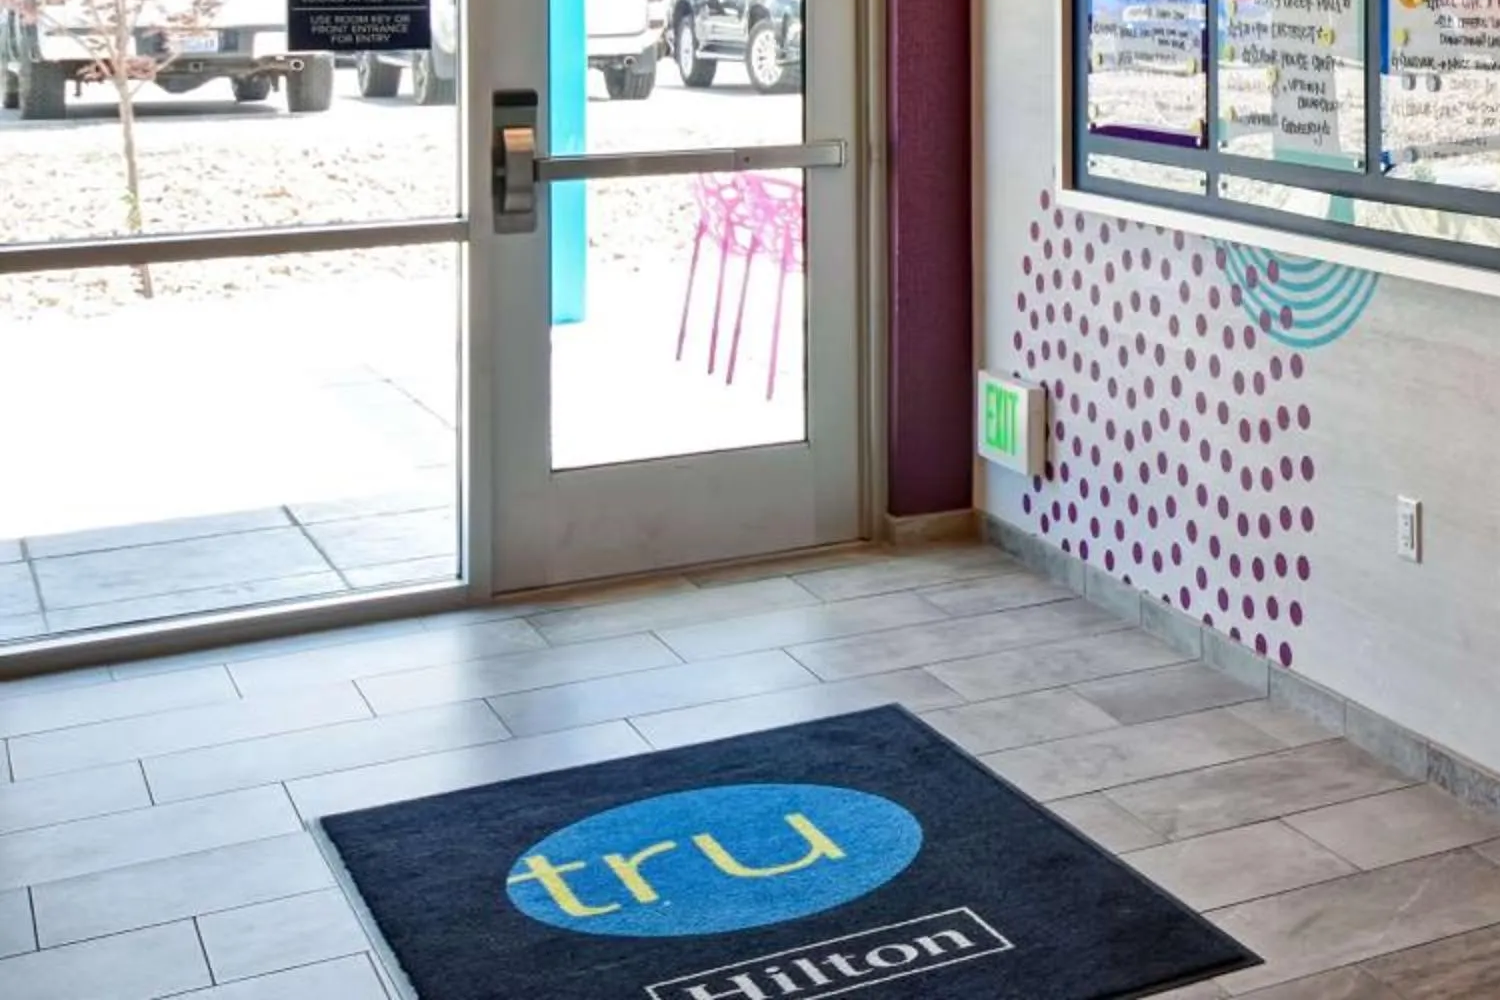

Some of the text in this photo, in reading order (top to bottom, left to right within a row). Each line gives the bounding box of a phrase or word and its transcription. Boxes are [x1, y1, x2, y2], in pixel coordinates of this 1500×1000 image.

[310, 15, 411, 25] USE ROOM KEY OR
[311, 24, 409, 34] FRONT ENTRANCE
[331, 33, 391, 43] FOR ENTRY
[985, 382, 1020, 457] EXIT
[506, 812, 848, 918] tru
[686, 928, 977, 1000] Hilton
